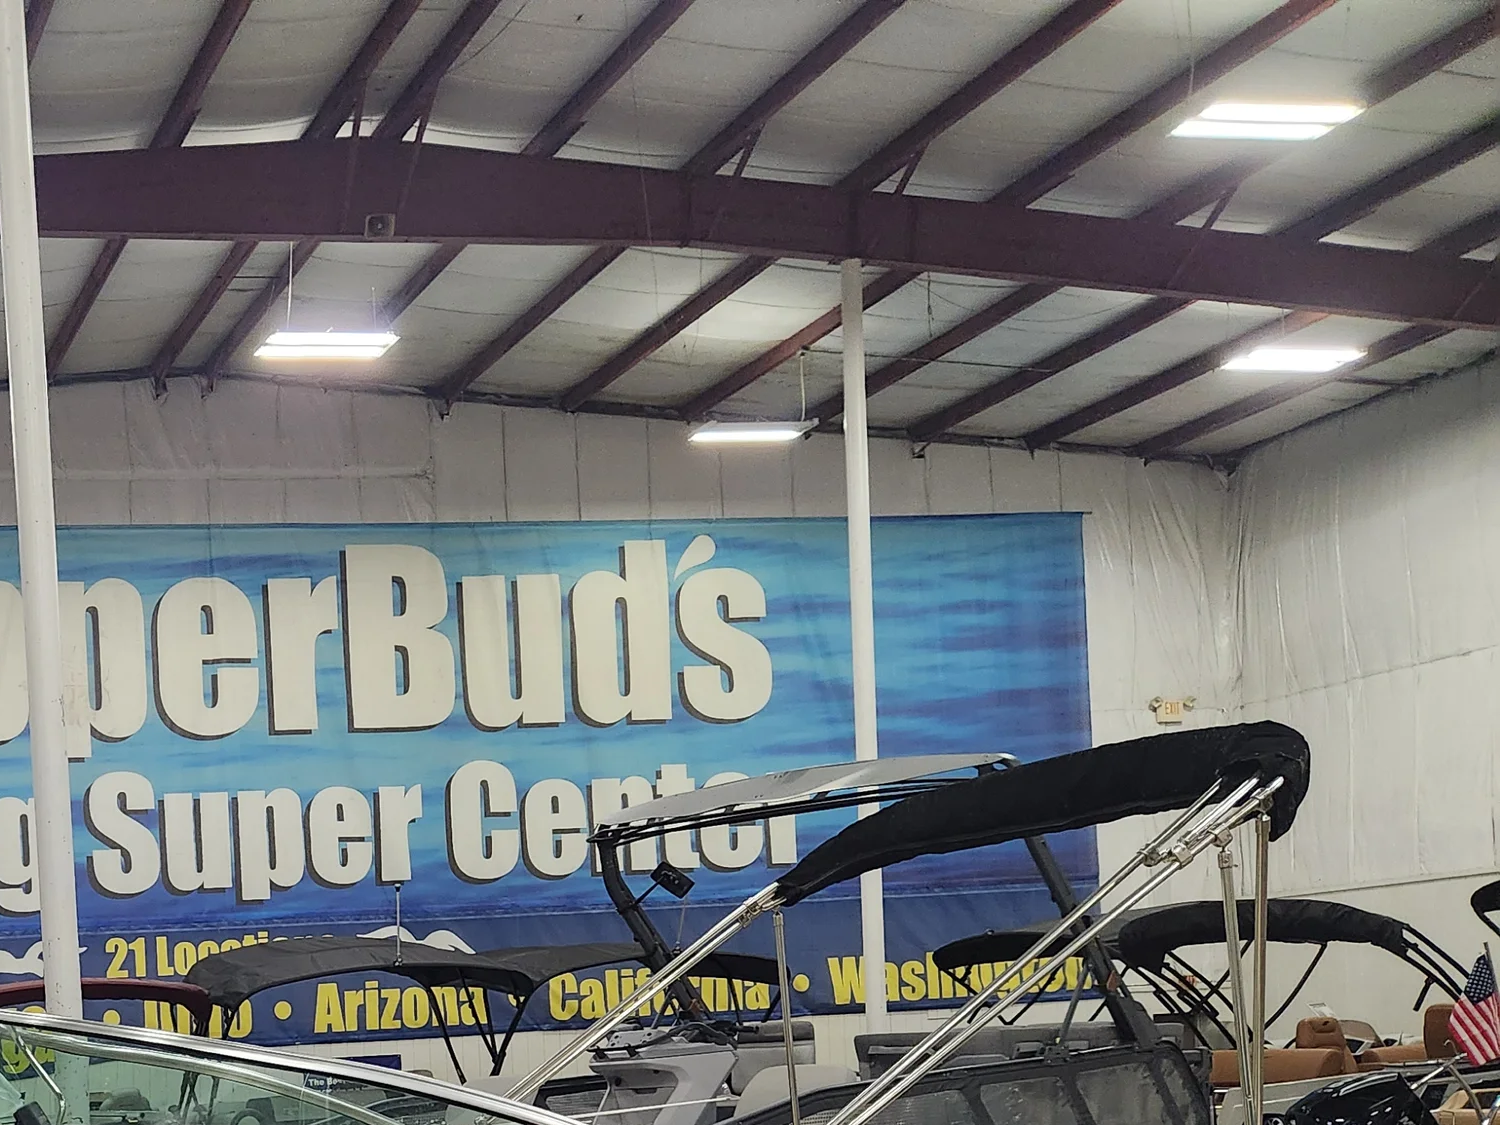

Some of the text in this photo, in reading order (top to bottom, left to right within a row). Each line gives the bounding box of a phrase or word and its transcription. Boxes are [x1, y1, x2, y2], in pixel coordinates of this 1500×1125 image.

[1165, 702, 1180, 715] EXIT
[84, 771, 423, 904] Super
[105, 935, 147, 979] 21
[313, 979, 489, 1034] Arizona
